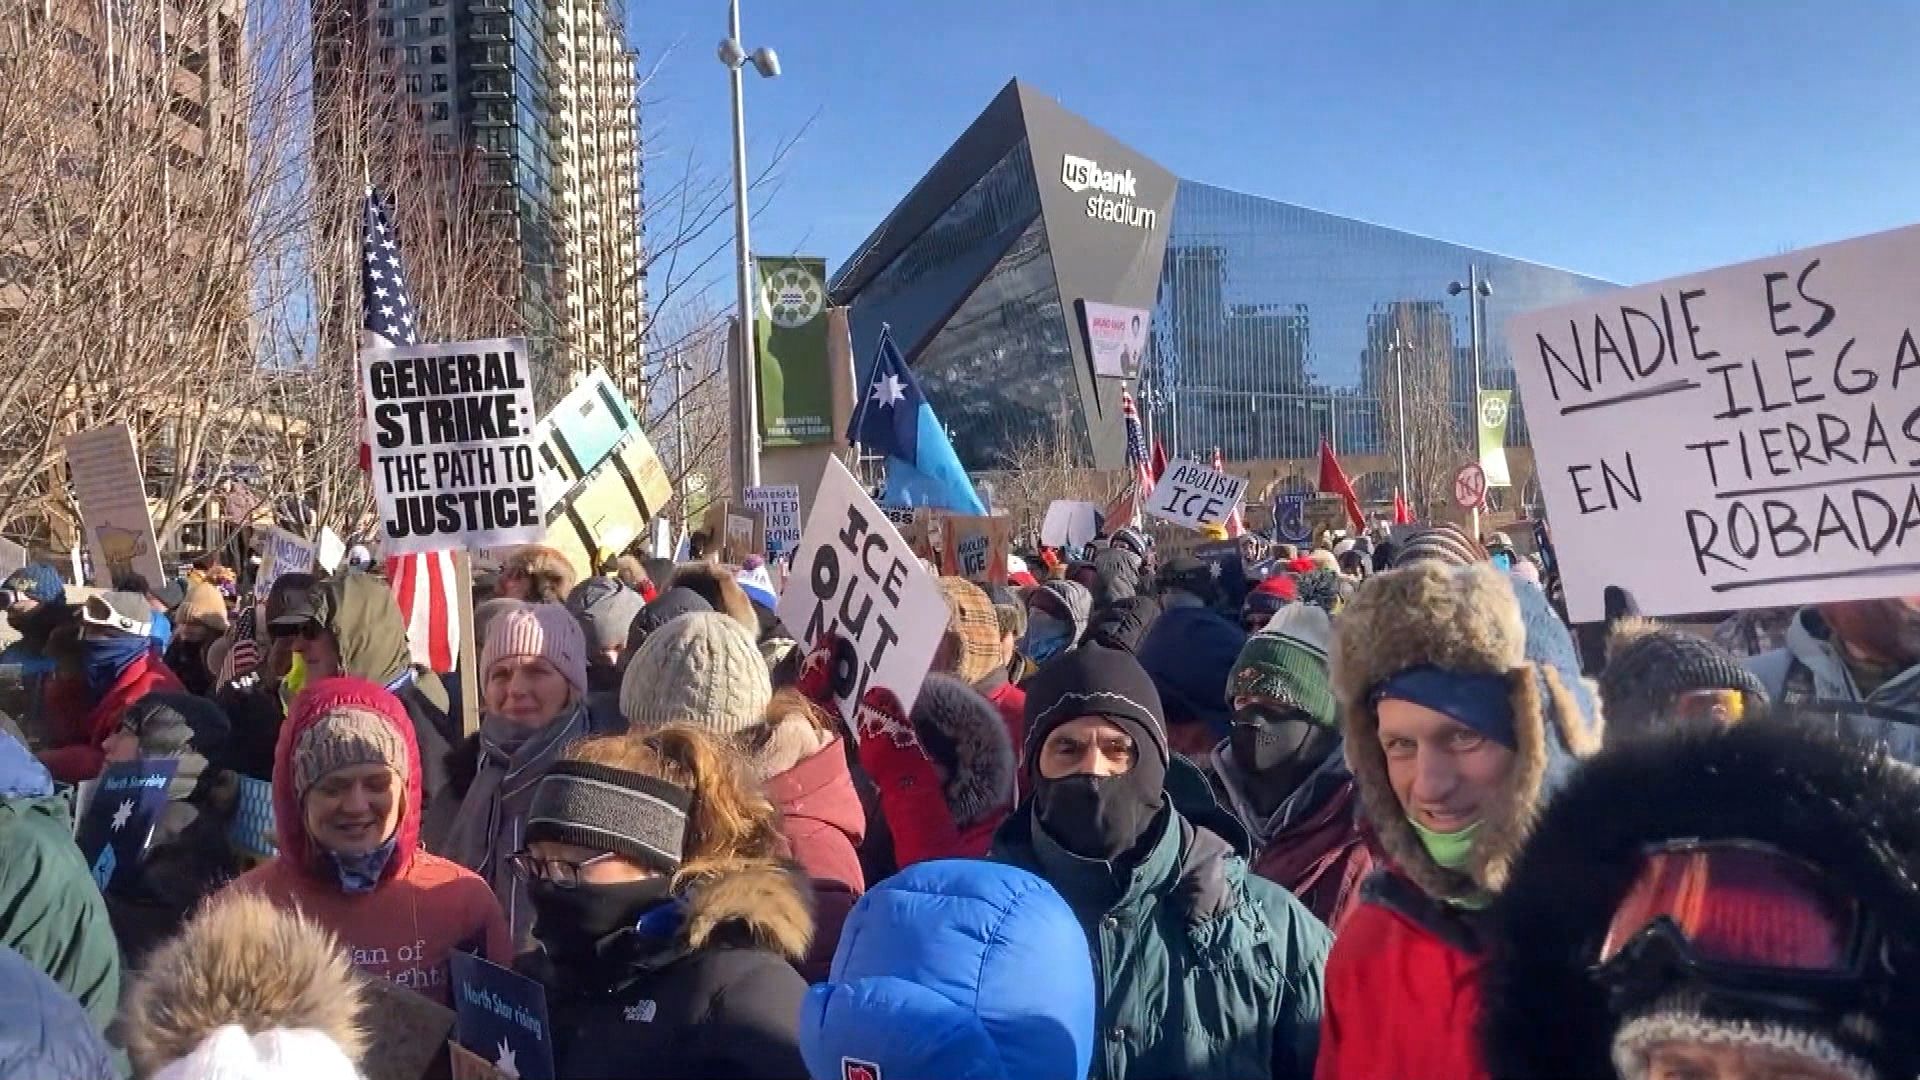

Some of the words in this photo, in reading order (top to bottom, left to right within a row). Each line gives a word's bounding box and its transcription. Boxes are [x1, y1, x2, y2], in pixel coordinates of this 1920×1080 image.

[1085, 194, 1156, 231] stadium
[1536, 289, 1720, 401] NADIE
[1764, 259, 1836, 338] ES
[370, 352, 525, 400] GENERAL
[375, 394, 530, 448] STRIKE:
[378, 453, 430, 493] THE
[434, 444, 496, 488] PATH
[500, 443, 534, 483] TO
[1171, 465, 1239, 499] ABOLISH
[1568, 451, 1642, 514] EN
[386, 487, 539, 538] JUSTICE
[766, 515, 791, 527] IND
[1162, 485, 1224, 523] ICE
[765, 529, 800, 542] RONG
[839, 503, 909, 609] ICE
[963, 552, 986, 576] ICE
[811, 544, 899, 673] OUT
[144, 773, 167, 789] rising
[397, 939, 425, 962] of
[463, 980, 493, 1012] North
[491, 993, 513, 1020] Star
[514, 1003, 542, 1041] rising
